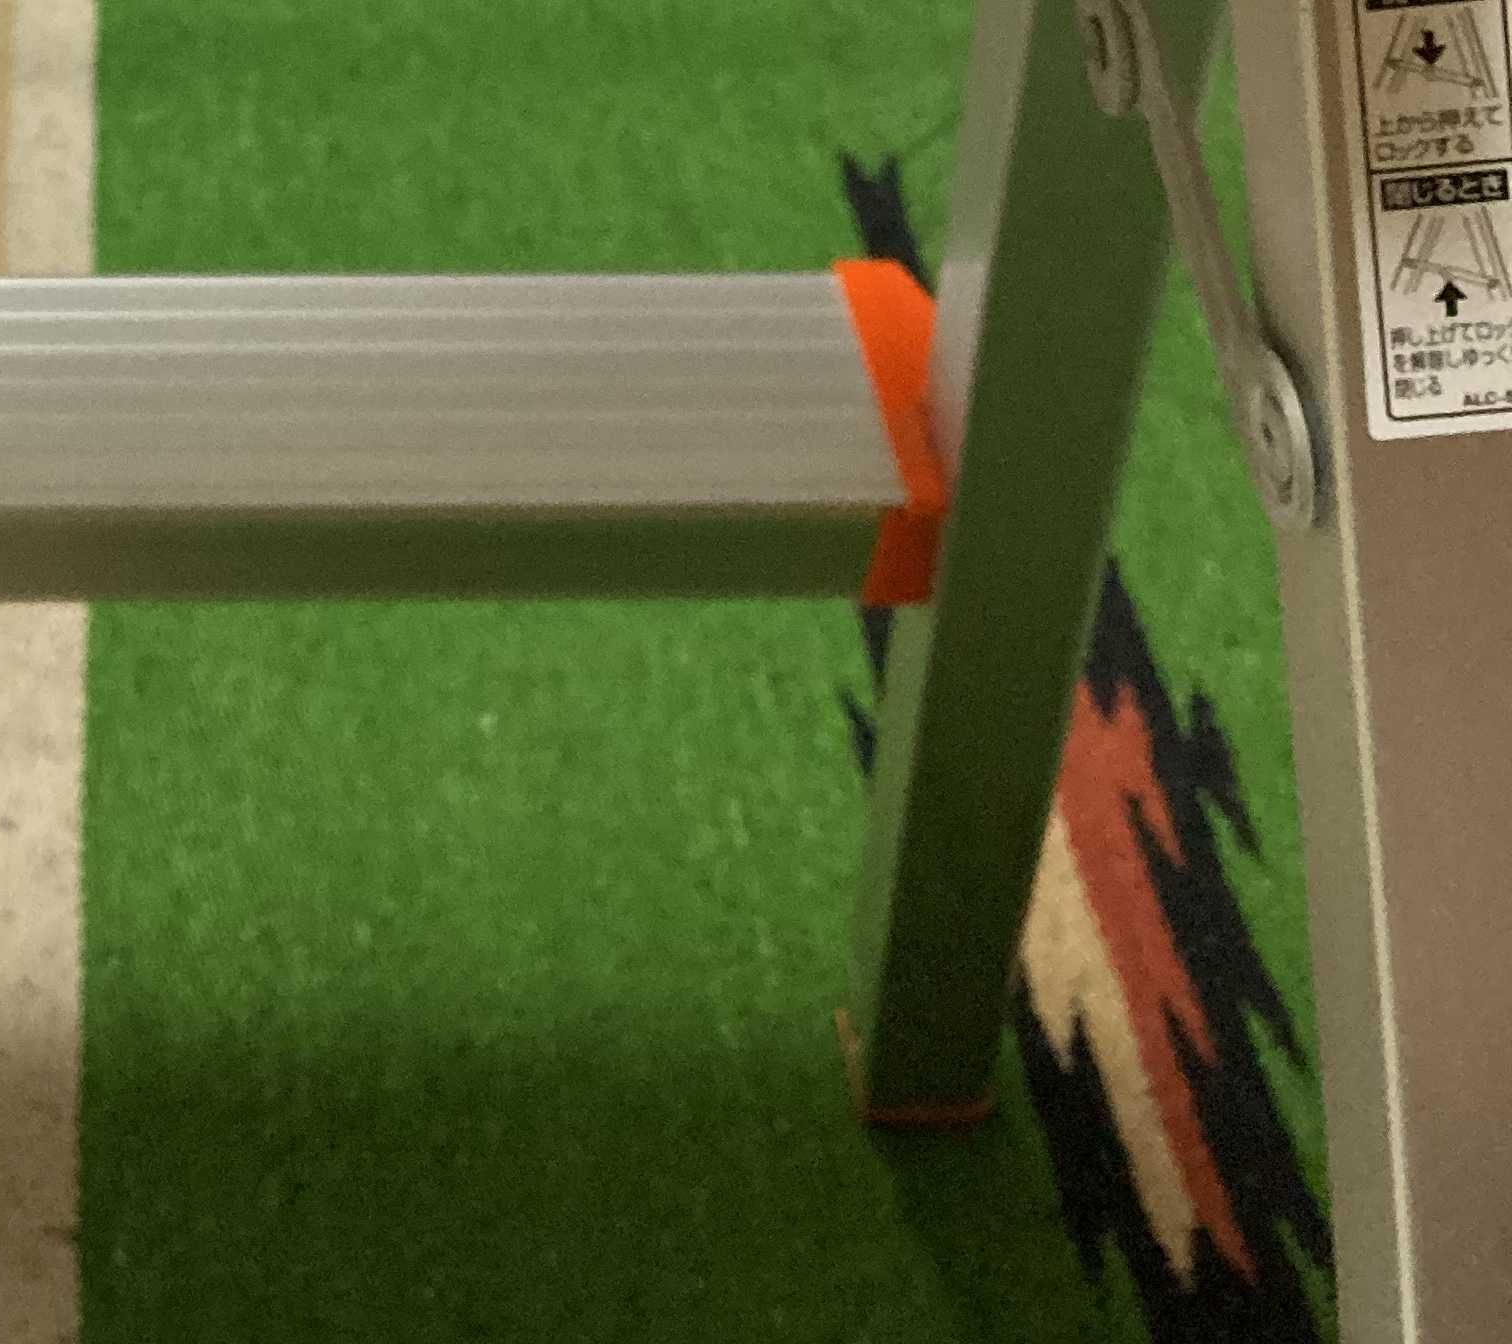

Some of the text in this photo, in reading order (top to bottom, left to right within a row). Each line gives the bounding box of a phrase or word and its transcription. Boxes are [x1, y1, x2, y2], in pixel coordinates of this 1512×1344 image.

[1389, 320, 1512, 350] 押し上げてロッ
